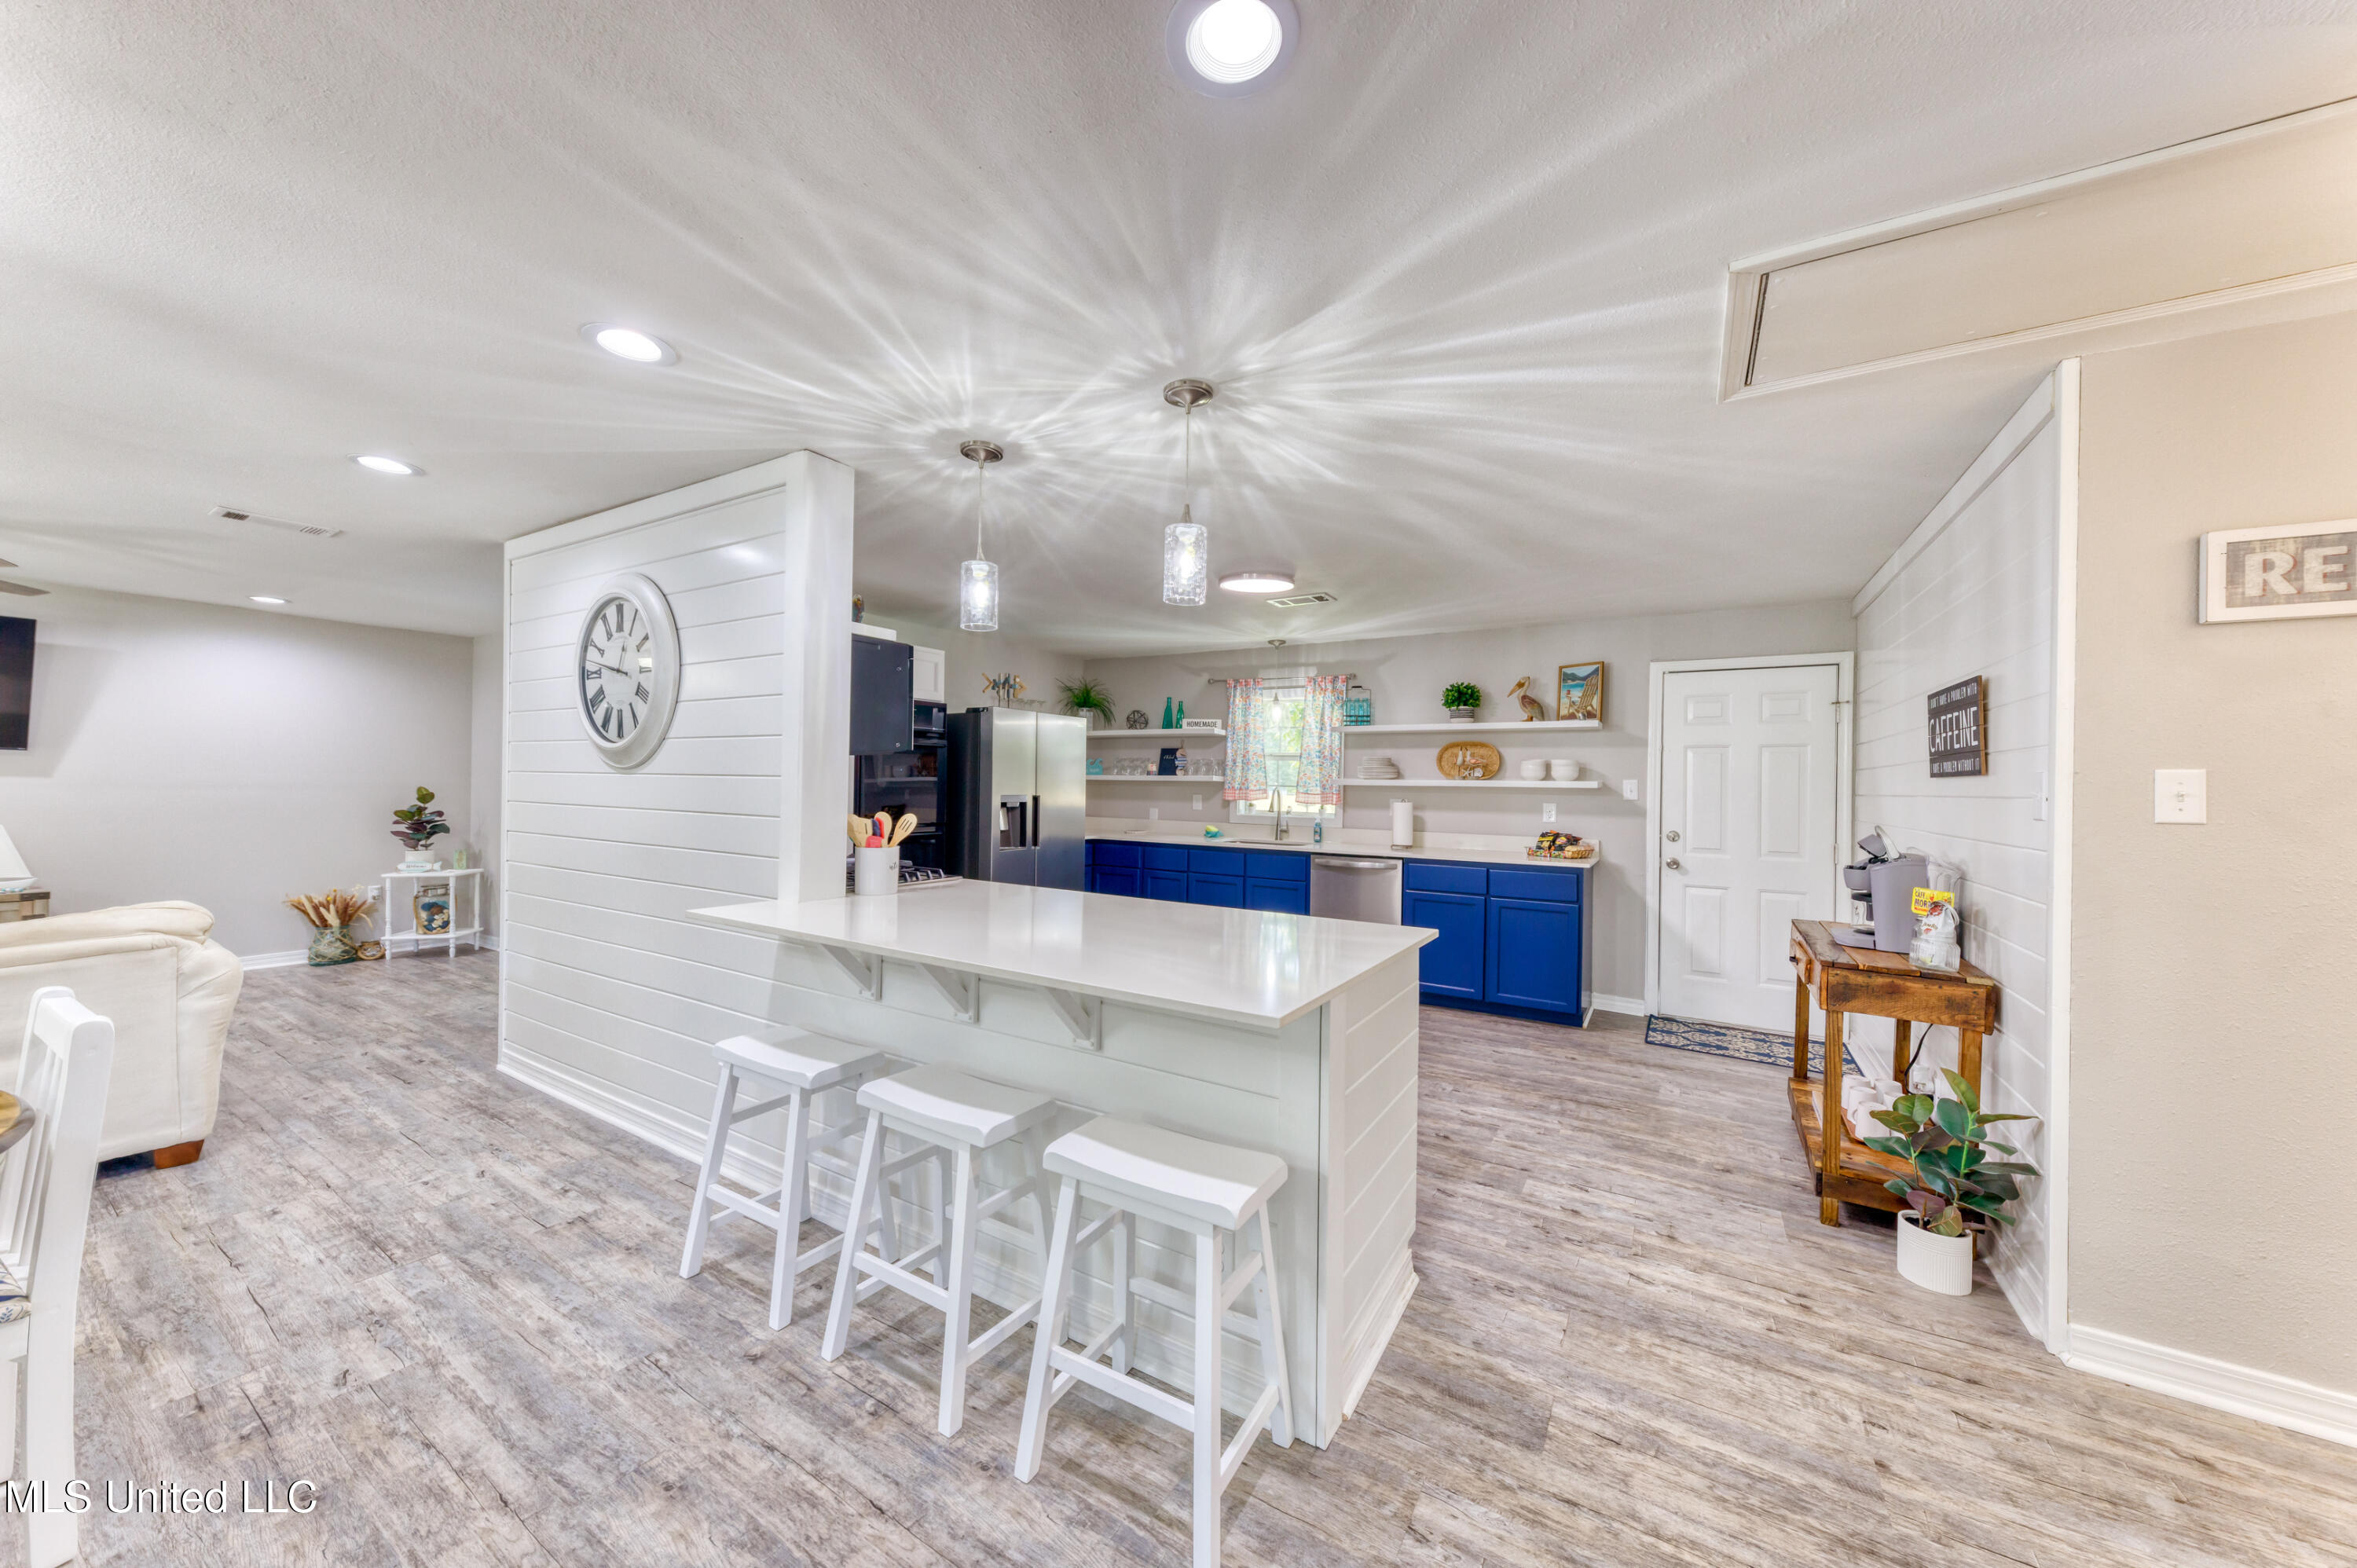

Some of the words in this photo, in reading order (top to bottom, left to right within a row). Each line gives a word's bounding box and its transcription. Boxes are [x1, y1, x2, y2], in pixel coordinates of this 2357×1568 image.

[2245, 545, 2357, 597] RE
[1930, 696, 1939, 709] DON'T
[1951, 686, 1967, 702] PROBLEM
[1967, 682, 1978, 696] WITH
[1930, 706, 1978, 753] CAFFEINE
[1943, 760, 1957, 773] PROBLEM
[1958, 758, 1974, 772] WITHOUT
[1974, 757, 1979, 771] IT
